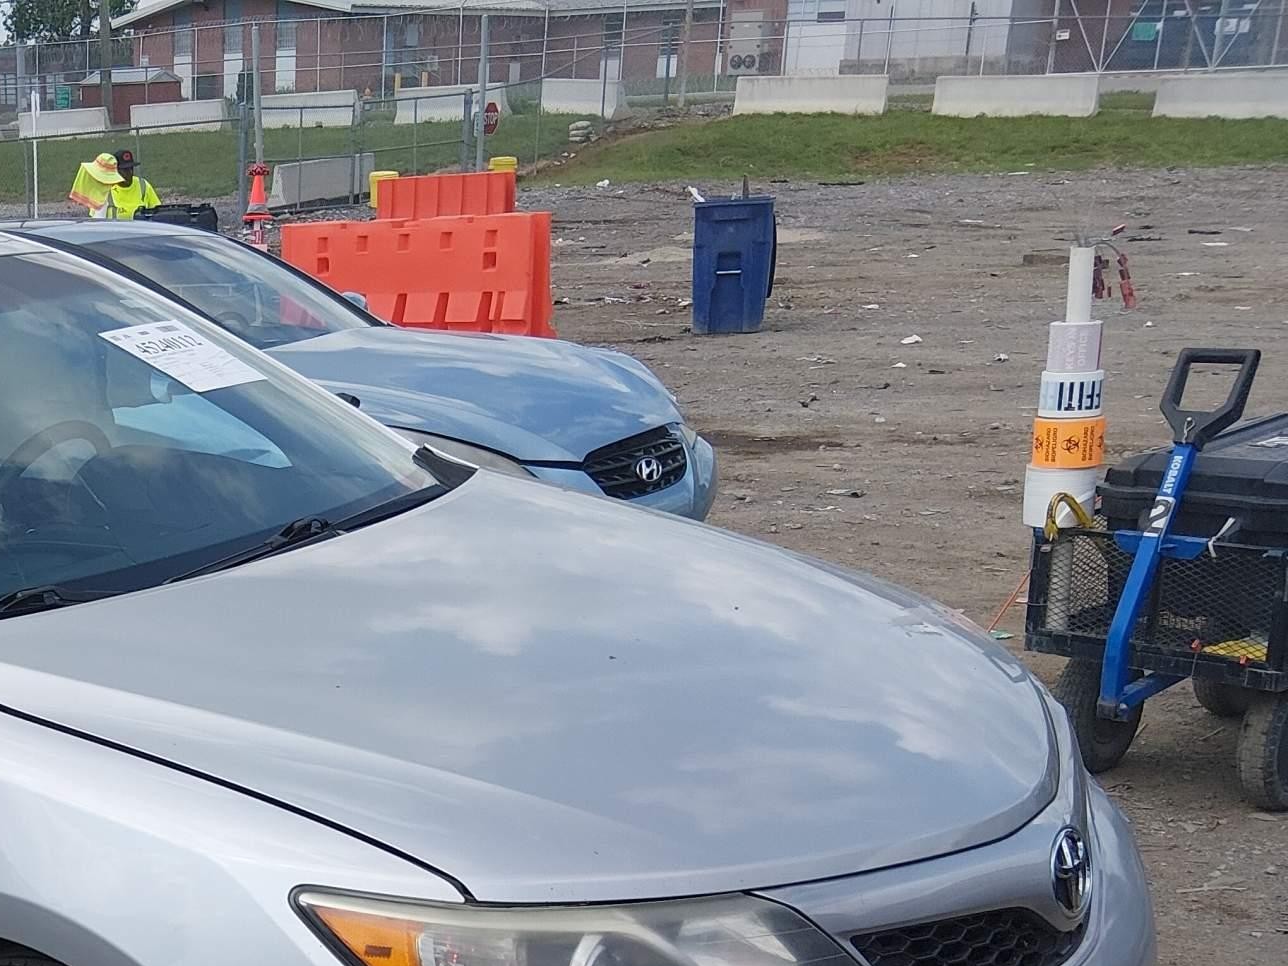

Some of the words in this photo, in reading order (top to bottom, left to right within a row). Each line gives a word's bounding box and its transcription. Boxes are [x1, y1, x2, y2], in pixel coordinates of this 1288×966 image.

[484, 111, 499, 125] STOP
[135, 334, 203, 355] 45240112
[1162, 455, 1184, 494] KOBALT
